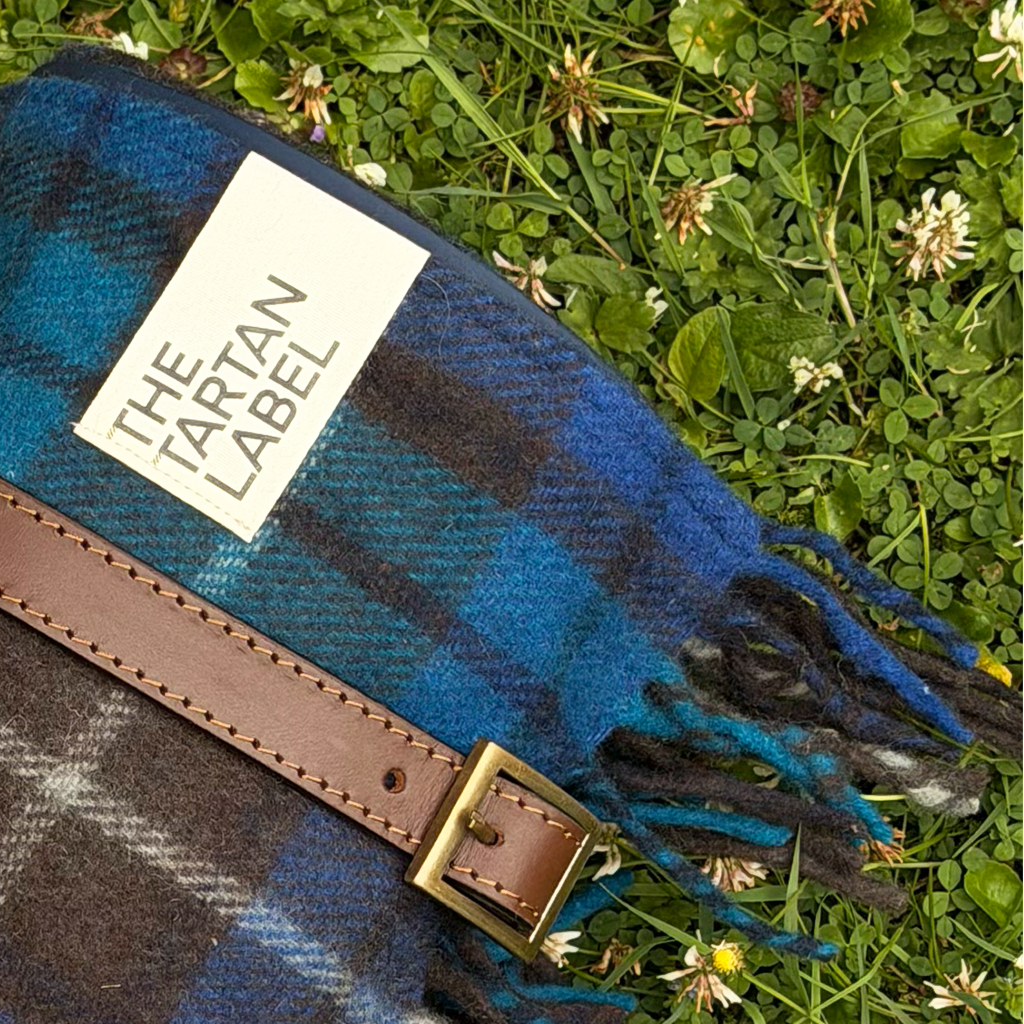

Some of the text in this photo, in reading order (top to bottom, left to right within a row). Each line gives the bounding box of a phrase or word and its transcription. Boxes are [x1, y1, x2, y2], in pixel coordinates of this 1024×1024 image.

[106, 341, 204, 446] THE
[151, 273, 308, 474] TARTAN
[204, 340, 340, 501] LABEL
